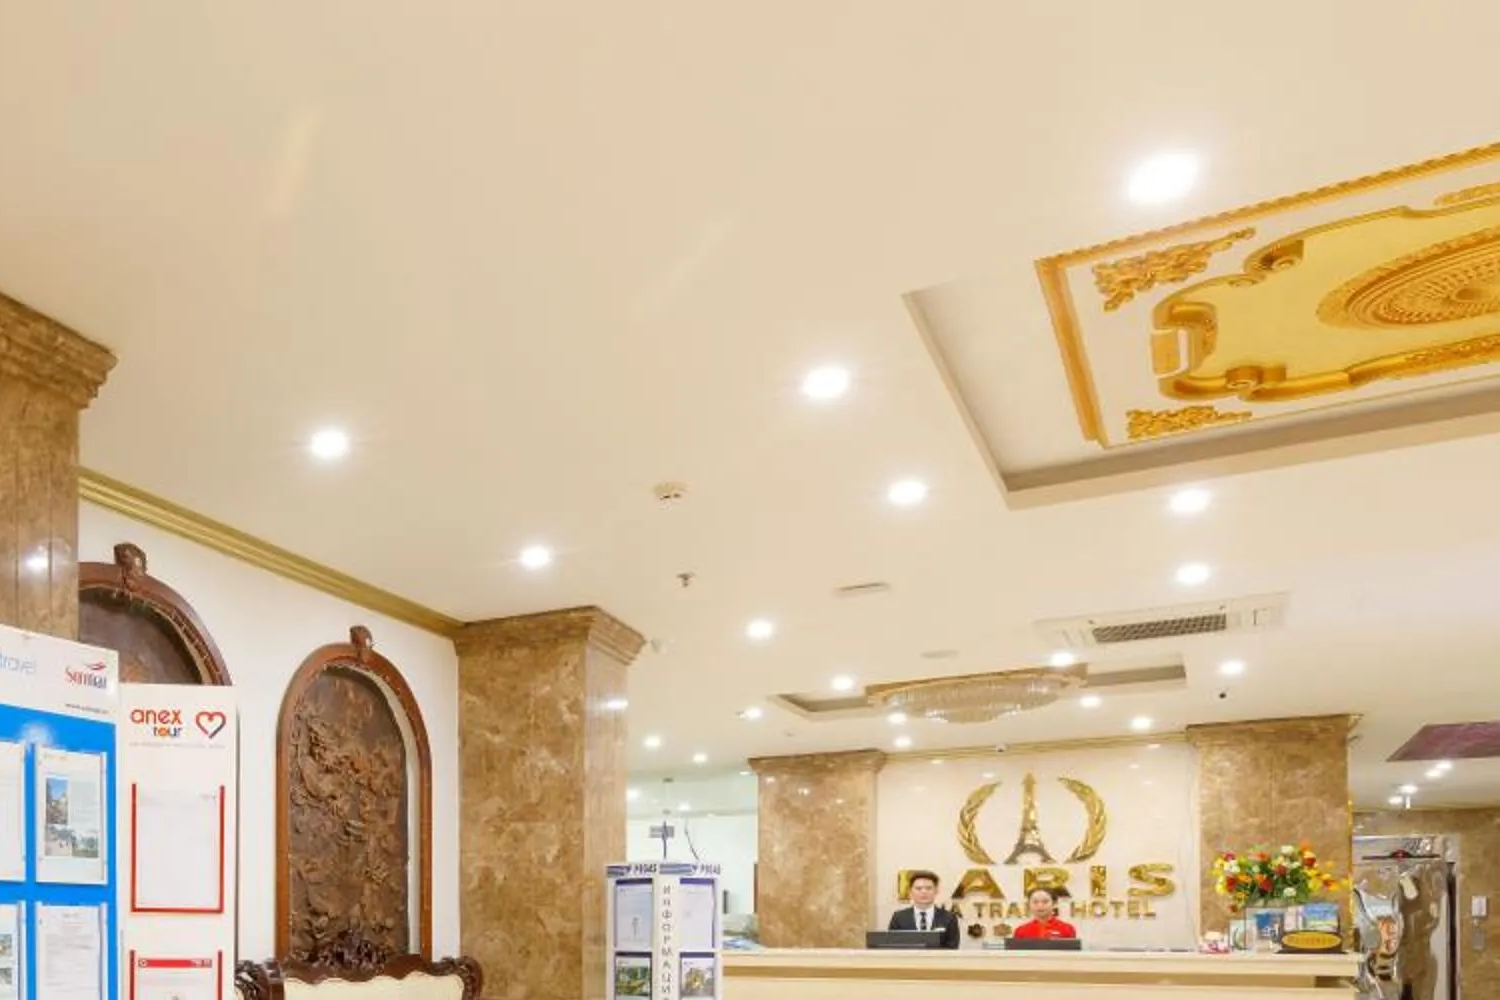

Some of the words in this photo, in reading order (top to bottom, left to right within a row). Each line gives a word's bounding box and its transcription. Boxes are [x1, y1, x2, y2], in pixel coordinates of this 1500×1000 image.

[130, 708, 183, 724] anex
[153, 726, 183, 737] tour
[1070, 902, 1157, 919] HOTEL
